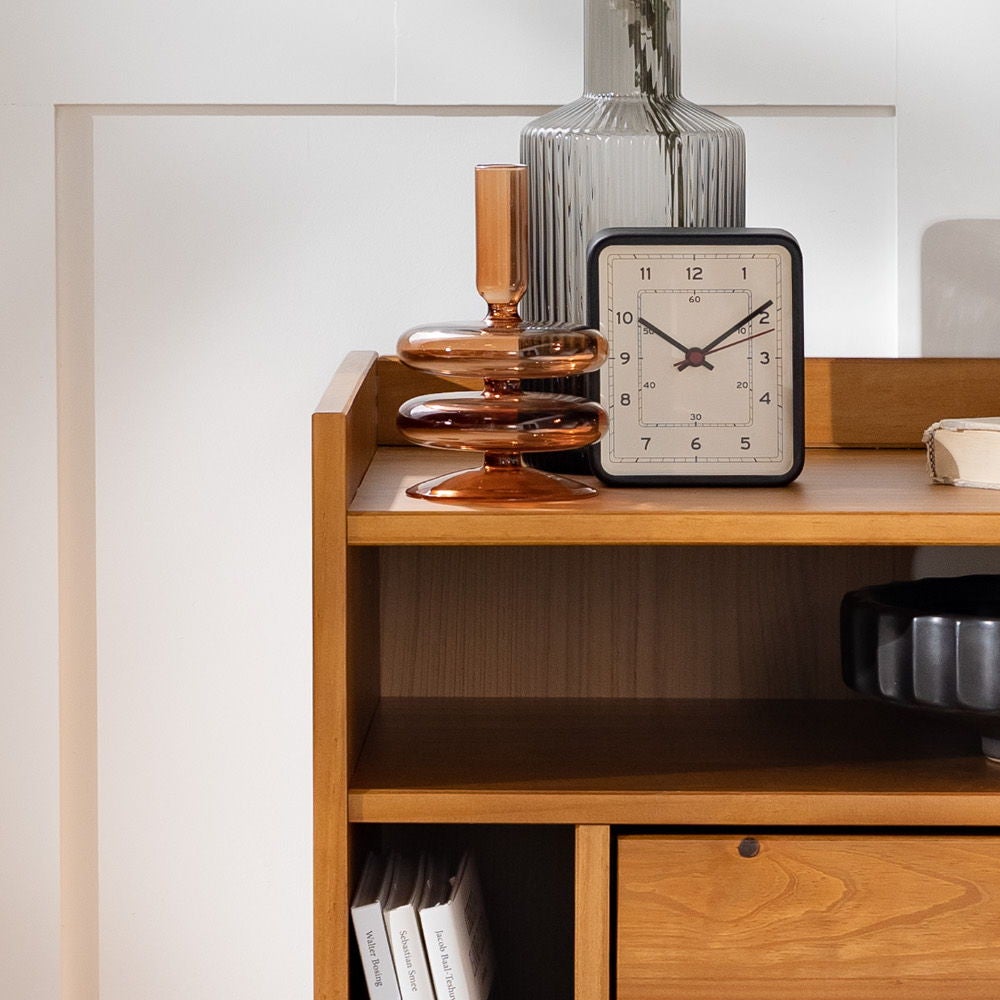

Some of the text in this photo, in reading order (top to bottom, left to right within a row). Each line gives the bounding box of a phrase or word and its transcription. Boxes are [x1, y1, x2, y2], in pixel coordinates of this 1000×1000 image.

[640, 267, 651, 280] 11
[686, 267, 703, 280] 12
[741, 267, 747, 280] 1
[688, 295, 701, 303] 60
[616, 311, 633, 325] 10
[759, 311, 770, 325] 2
[620, 352, 630, 365] 9
[760, 352, 770, 365] 3
[643, 381, 656, 389] 40
[736, 381, 748, 389] 20
[620, 393, 631, 406] 8
[759, 392, 771, 405] 4
[690, 413, 702, 421] 30
[641, 437, 651, 450] 7
[691, 437, 701, 450] 6
[740, 437, 750, 450] 5
[434, 929, 445, 953] Jacob
[364, 930, 383, 988] Walter Bosing
[399, 929, 418, 992] Sebastian Smee
